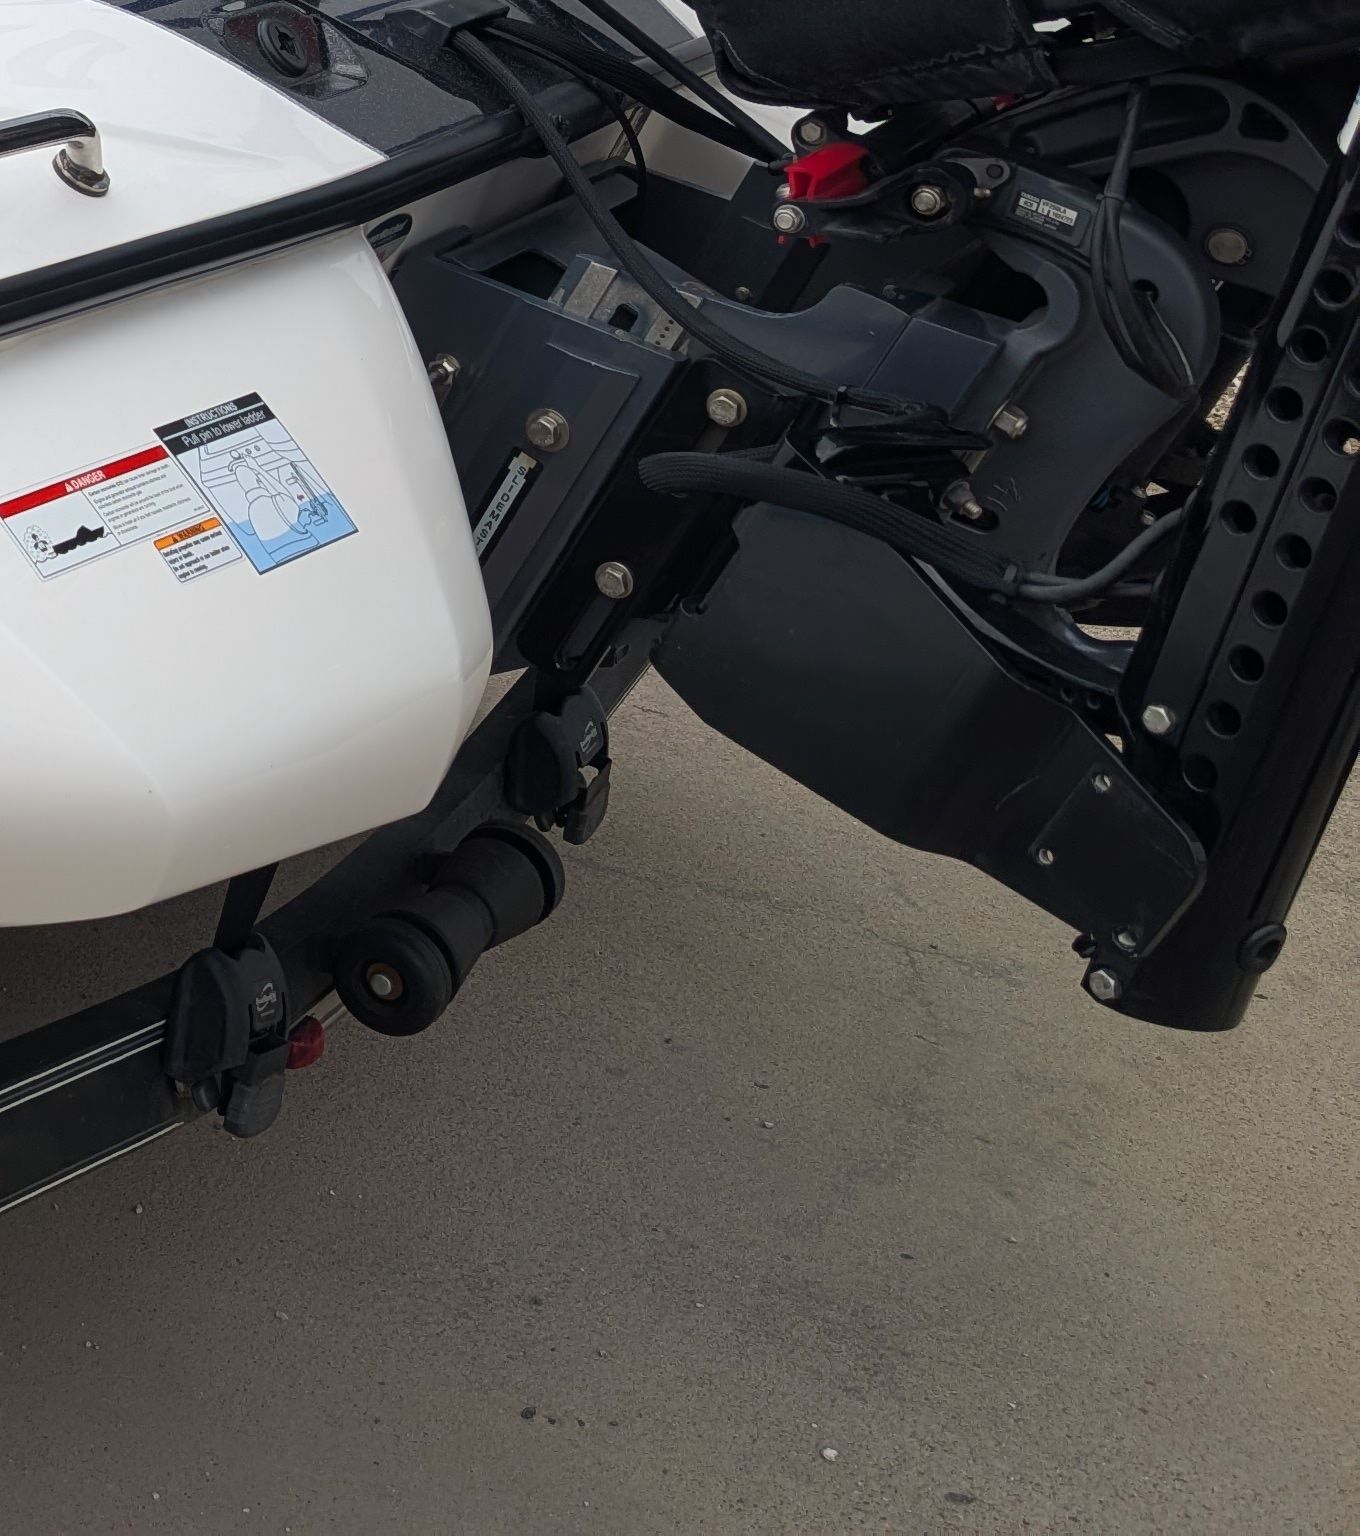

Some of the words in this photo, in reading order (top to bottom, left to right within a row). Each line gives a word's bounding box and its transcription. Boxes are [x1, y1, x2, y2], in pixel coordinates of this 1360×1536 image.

[184, 402, 238, 427] INSTRUCTIONS
[181, 433, 201, 447] Pull
[198, 428, 214, 443] pin
[211, 424, 222, 438] to
[219, 419, 242, 435] lower
[240, 409, 267, 426] ladder
[72, 469, 106, 491] DANGER
